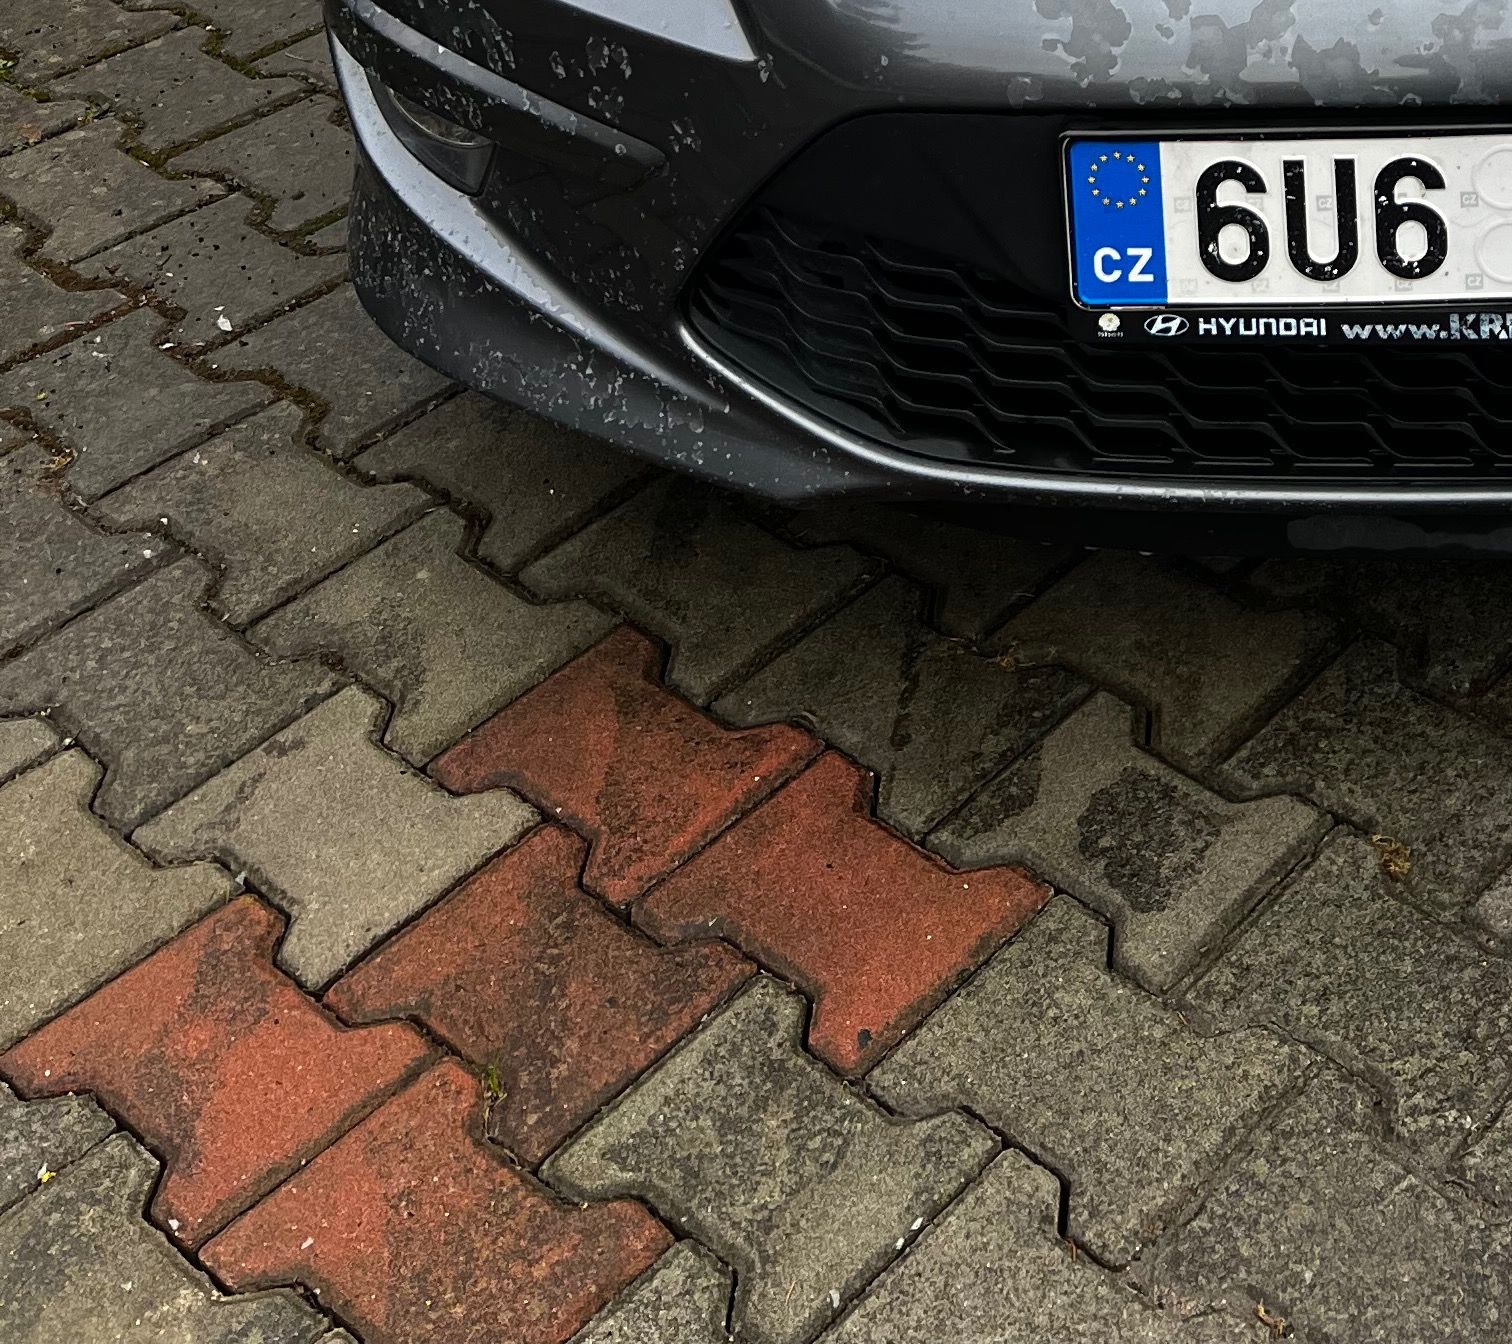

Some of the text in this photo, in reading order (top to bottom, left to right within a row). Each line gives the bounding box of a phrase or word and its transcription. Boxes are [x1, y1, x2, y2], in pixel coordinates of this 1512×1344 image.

[1195, 156, 1448, 282] 6U6
[1093, 247, 1155, 283] CZ
[1199, 317, 1326, 336] HYUNDAI
